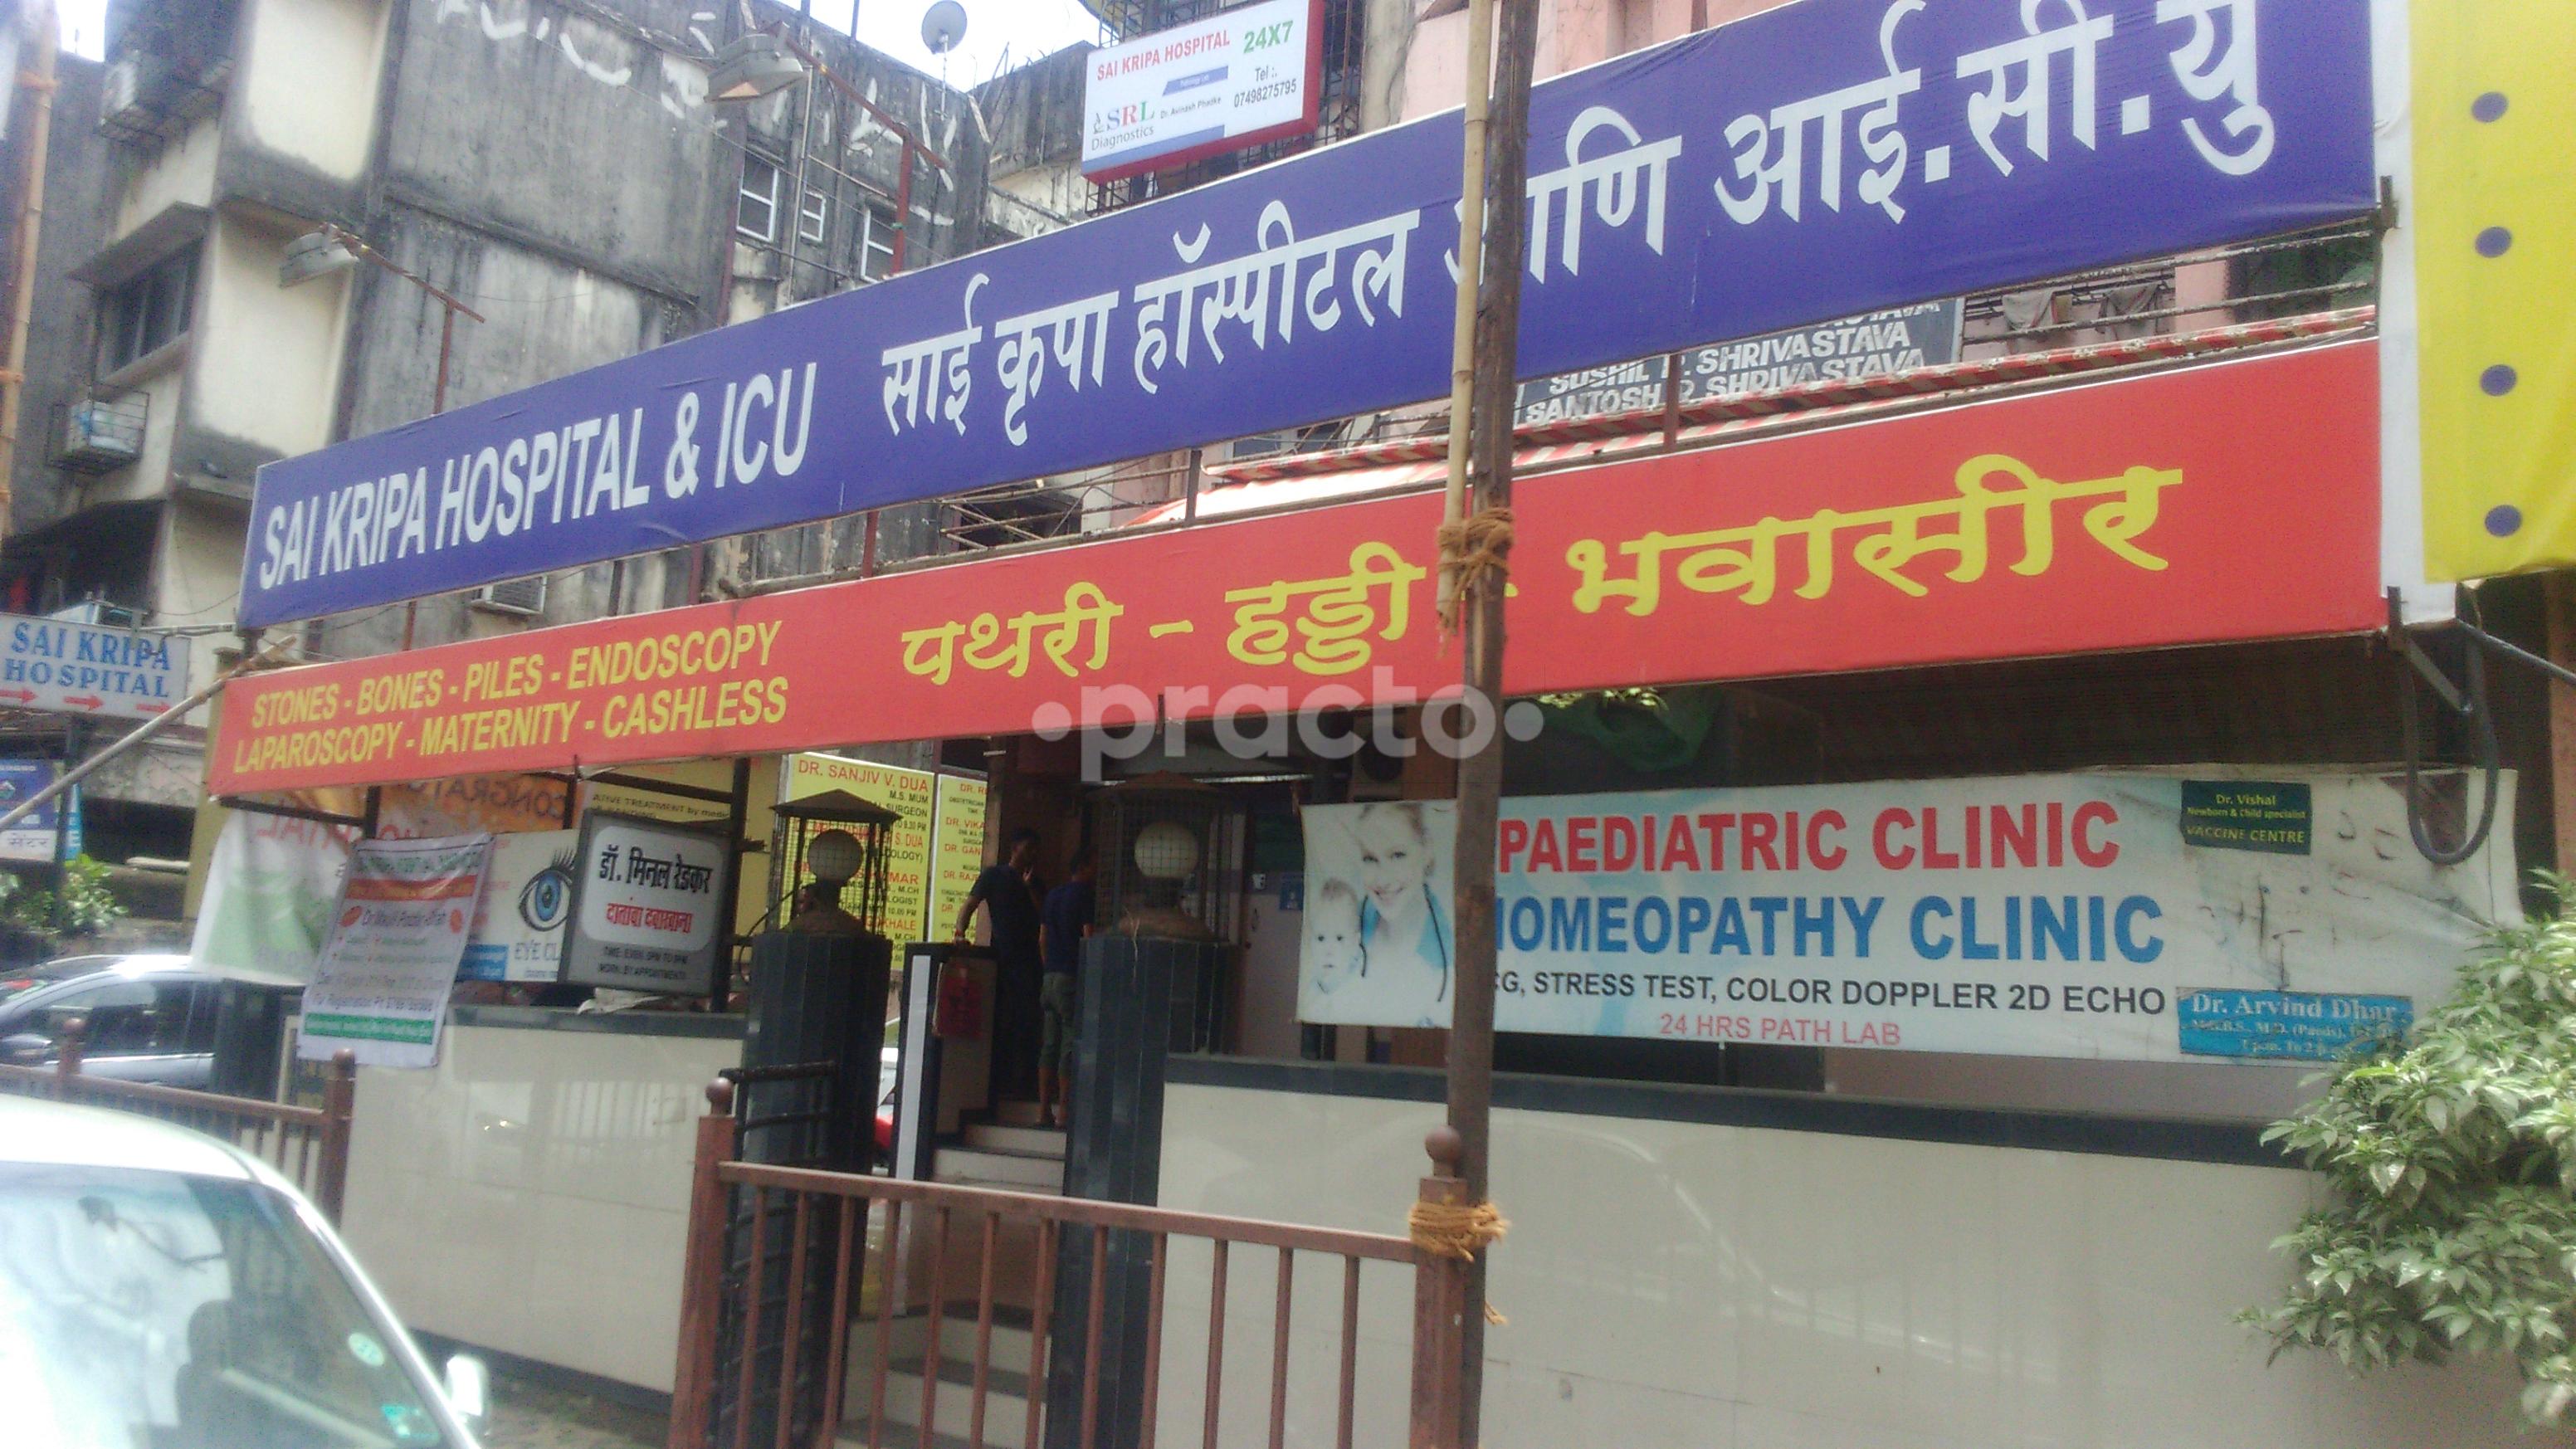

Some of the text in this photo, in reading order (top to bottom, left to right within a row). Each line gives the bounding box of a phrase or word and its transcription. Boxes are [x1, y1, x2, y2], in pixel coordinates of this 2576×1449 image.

[1097, 30, 1231, 81] SAI KRIPA HOSPITAL
[1243, 20, 1294, 54] 24X7
[1106, 100, 1155, 130] SRL
[1233, 78, 1297, 109] 07498275795
[1091, 125, 1154, 151] Diagnostics
[881, 272, 989, 436] साई
[994, 290, 1120, 446] कृपा
[1134, 199, 1420, 394] हॉस्पीटल
[1695, 321, 1910, 373] SHRIVASTAVA
[1525, 383, 1661, 422] SANTOSH
[1705, 349, 1925, 398] SHRIVASTAVA
[259, 362, 817, 590] SAI KRIPA HOSPITAL & ICU
[901, 582, 1124, 685] पथरी
[1225, 541, 1427, 675] हड्डी
[1566, 454, 2183, 616] भवासीर
[11, 622, 172, 671] SAI KRIPA
[3, 658, 171, 699] HOSPITAL
[251, 682, 341, 730] STONES
[356, 668, 446, 716] BONES
[462, 653, 544, 703] PILES
[566, 620, 782, 690] ENDOSCOPY
[233, 721, 403, 775] LAPAROSCOPY
[419, 700, 583, 757] MATERNITY
[603, 676, 789, 739] CASHLESS
[798, 759, 929, 792] DR. SANJIV V. DUA
[886, 803, 928, 817] SURGEON
[2215, 793, 2276, 806] Dr. Vishal
[905, 833, 924, 848] DUA
[1498, 800, 2121, 874] PAEDIATRIC CLINIC
[2187, 826, 2305, 844] VACCINE CENTRE
[1910, 894, 2164, 964] CLINIC
[1533, 971, 1635, 998] STRESS
[1643, 974, 1717, 1004] TEST,
[1726, 977, 1832, 1005] COLOR
[1841, 979, 1999, 1011] DOPPLER
[2008, 983, 2052, 1012] 2D
[2063, 985, 2166, 1016] ECHO
[2192, 993, 2228, 1014] Dr.
[2235, 996, 2323, 1018] Arvind
[1660, 1012, 1901, 1046] 24 HRS PATH LAB
